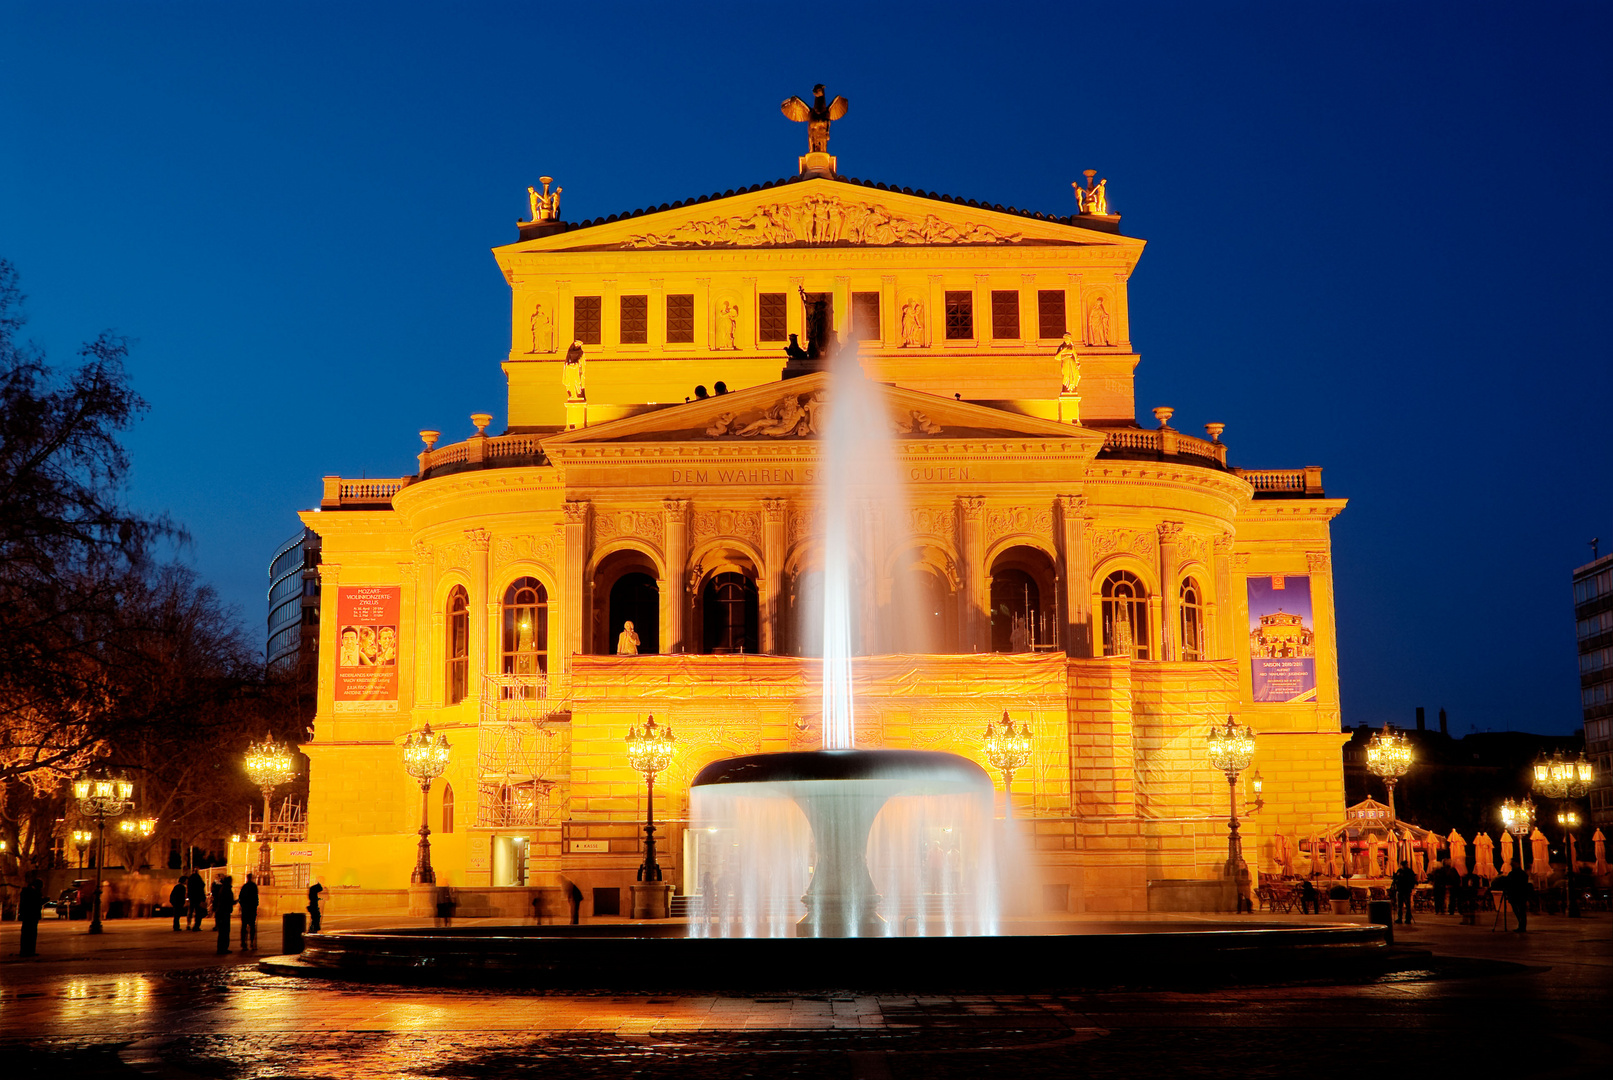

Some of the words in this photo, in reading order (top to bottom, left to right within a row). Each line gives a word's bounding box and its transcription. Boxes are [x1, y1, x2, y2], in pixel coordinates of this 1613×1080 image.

[672, 470, 708, 483] DEM
[718, 469, 794, 482] WAHREN
[911, 467, 975, 480] GUTEN.
